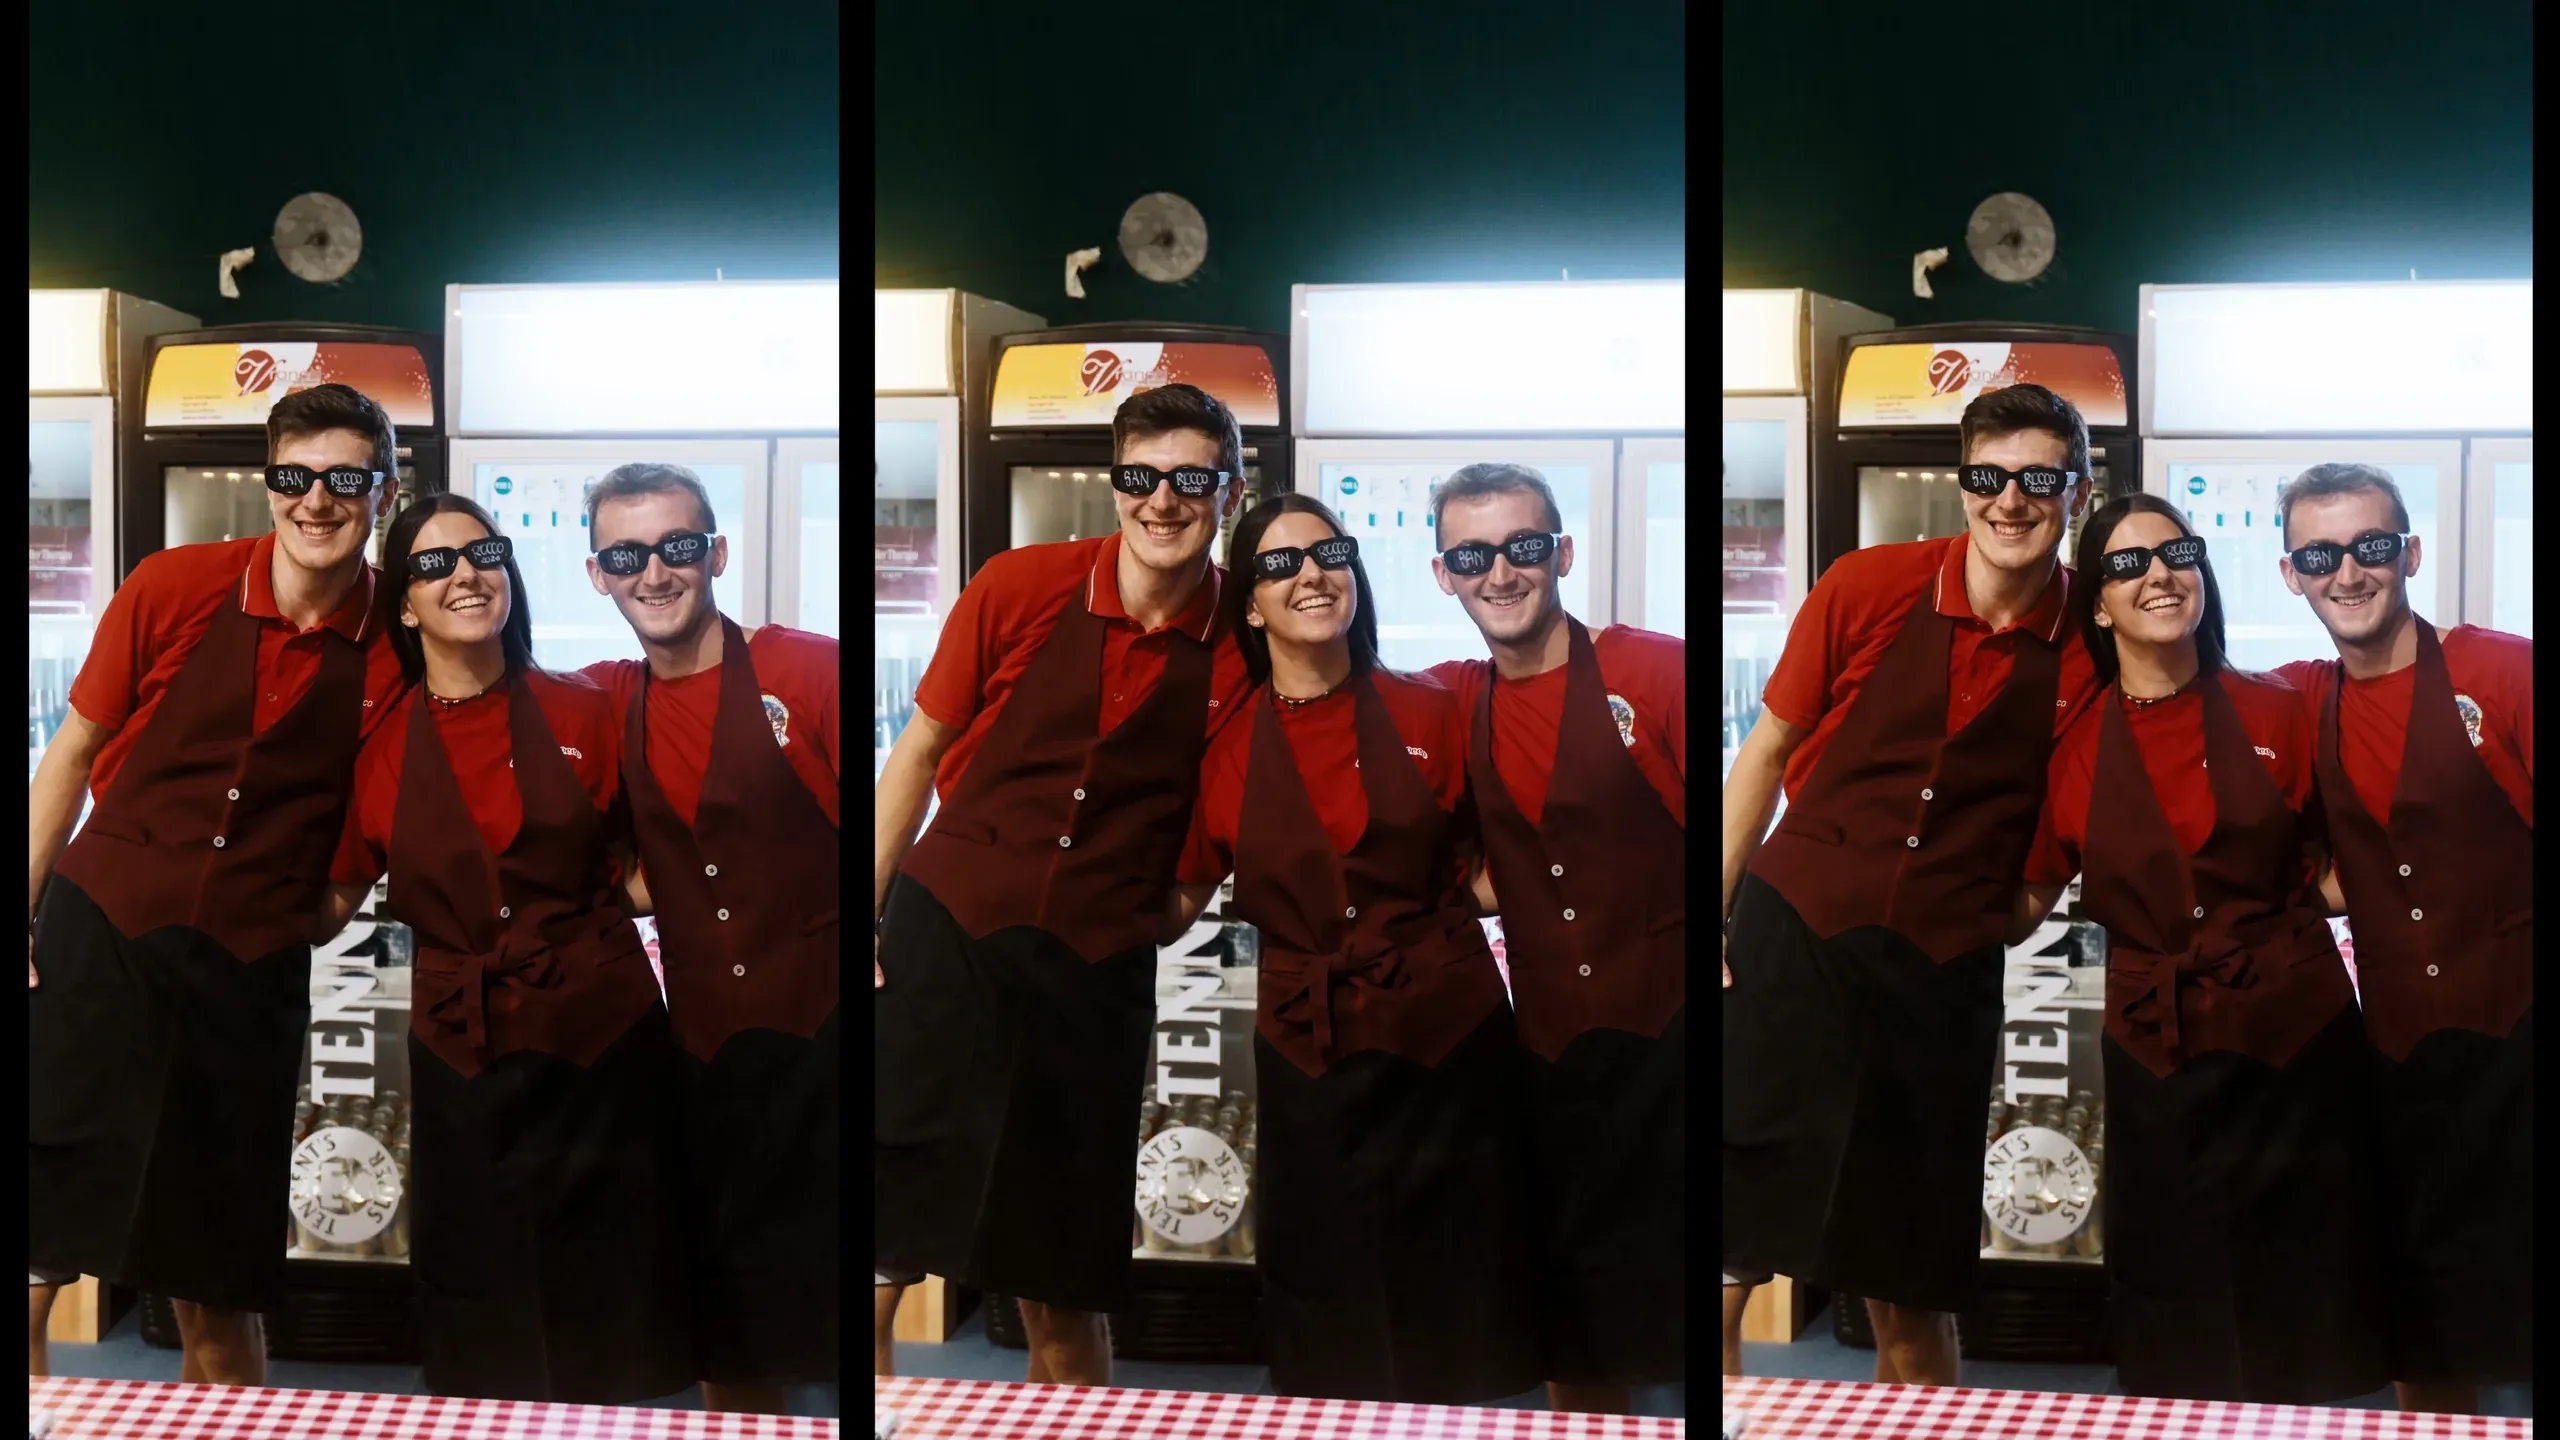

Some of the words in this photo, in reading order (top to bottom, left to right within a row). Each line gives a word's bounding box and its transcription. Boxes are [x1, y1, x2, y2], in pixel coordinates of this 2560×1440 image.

[277, 470, 305, 489] SAN
[329, 471, 363, 487] ROCCO
[1123, 470, 1151, 489] SAN
[1175, 471, 1209, 487] ROCCO
[1971, 470, 1999, 489] SAN
[2023, 471, 2057, 487] ROCCO
[470, 541, 505, 560] ROCCO
[663, 538, 699, 557] ROCCO
[1316, 541, 1351, 560] ROCCO
[1509, 538, 1545, 557] ROCCO
[2164, 541, 2199, 560] ROCCO
[2357, 538, 2393, 557] ROCCO
[310, 884, 377, 1106] TENN
[1156, 884, 1223, 1106] TENN
[2004, 884, 2071, 1106] TENN
[291, 1132, 337, 1236] TENENT'S
[367, 1150, 393, 1225] SUER
[1137, 1132, 1183, 1236] TENENT'S
[1213, 1150, 1239, 1225] SUER
[1985, 1132, 2031, 1236] TENENT'S
[2061, 1150, 2087, 1225] SUER
